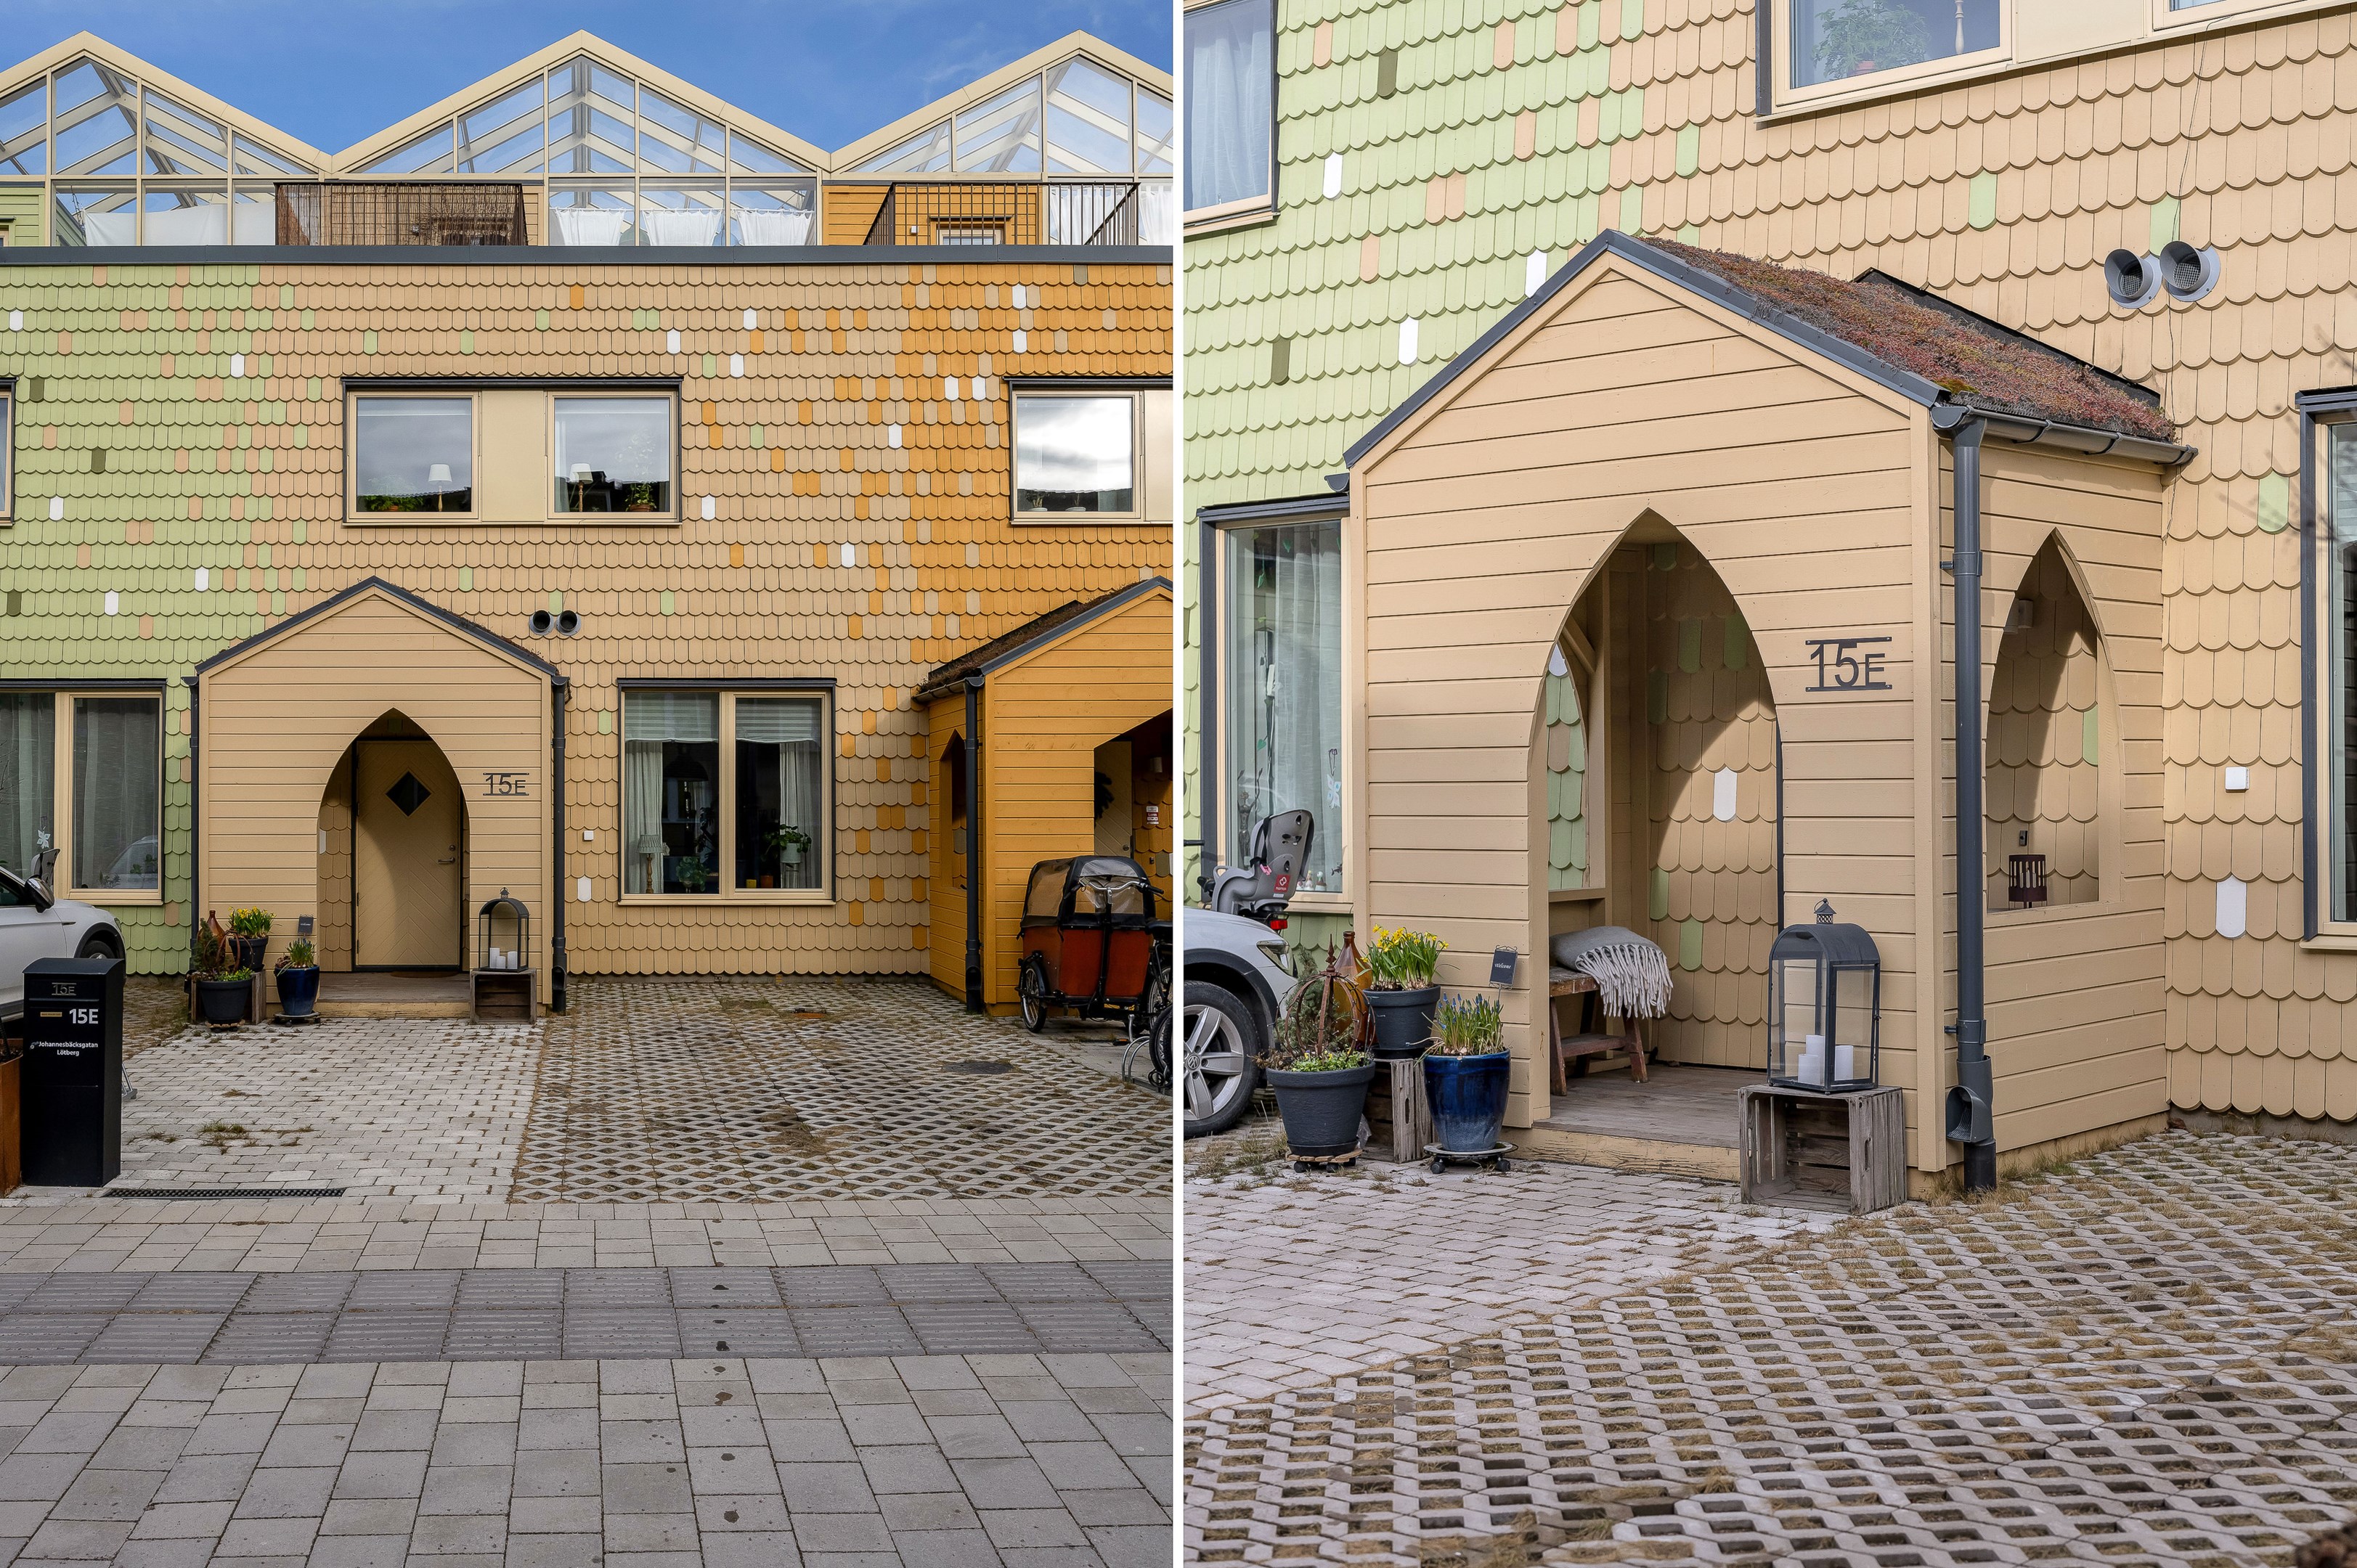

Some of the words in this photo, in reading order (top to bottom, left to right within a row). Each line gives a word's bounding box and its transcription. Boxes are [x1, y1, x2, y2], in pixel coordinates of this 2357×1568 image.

[1810, 640, 1886, 689] 15E
[485, 773, 526, 795] 15E
[53, 984, 75, 995] 15E
[69, 1008, 99, 1024] 15E
